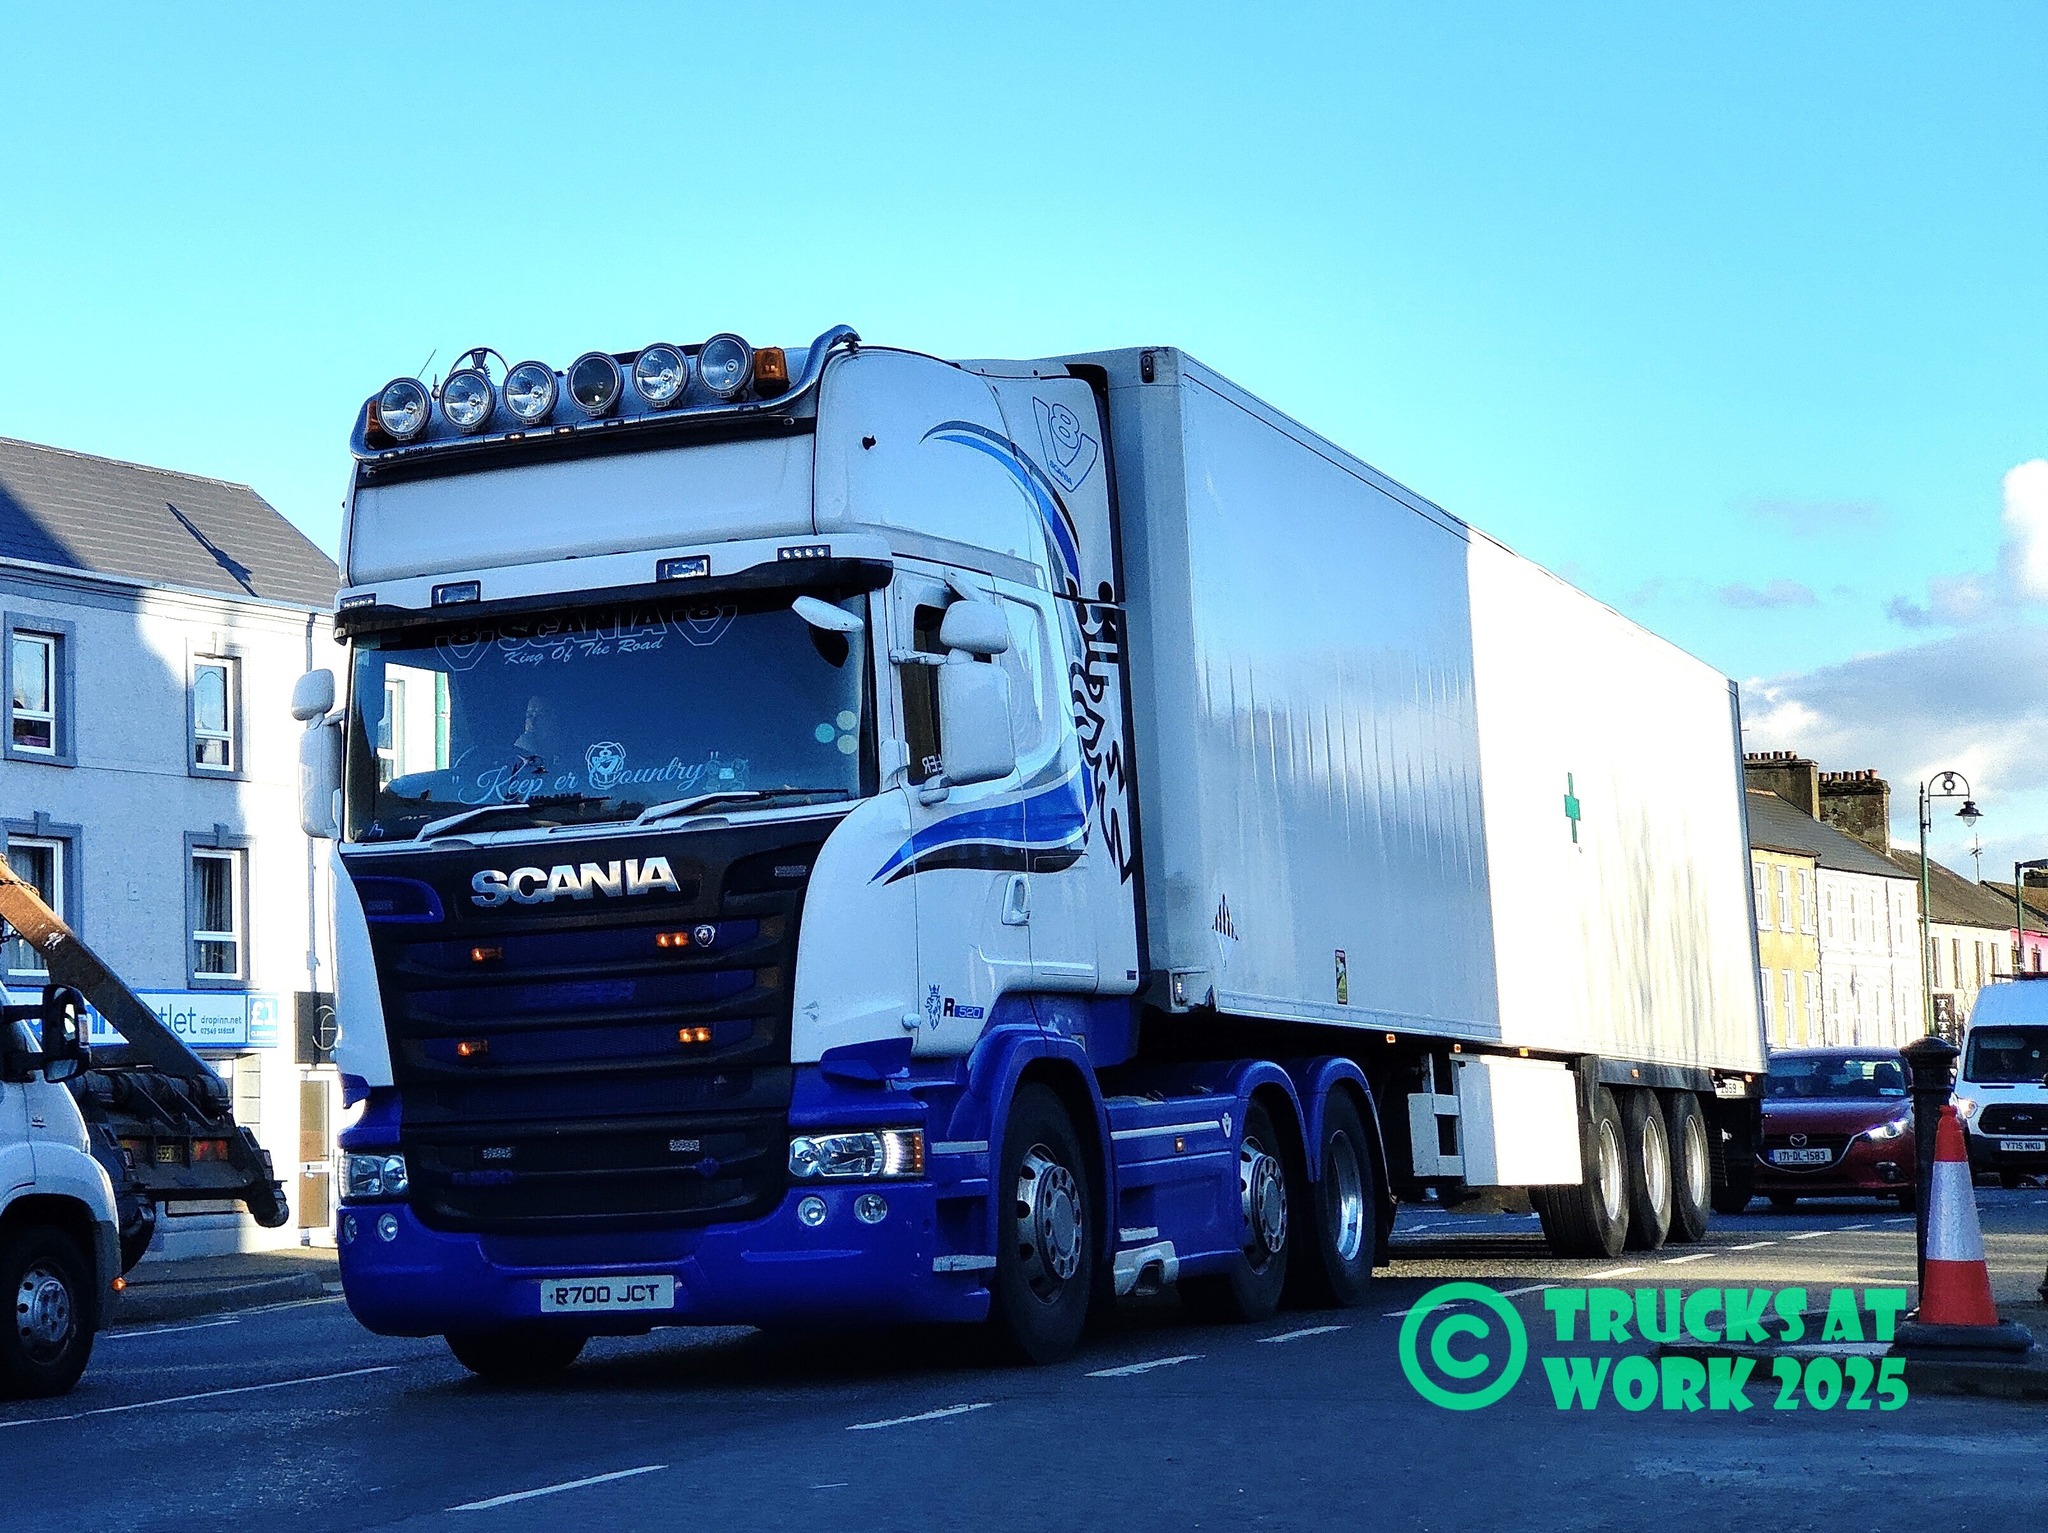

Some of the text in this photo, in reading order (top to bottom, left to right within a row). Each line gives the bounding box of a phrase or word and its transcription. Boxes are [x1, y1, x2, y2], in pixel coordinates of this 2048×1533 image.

[503, 637, 663, 666] King Of The Road
[554, 772, 578, 791] er
[471, 856, 681, 908] SCANIA
[943, 997, 981, 1018] R 520
[201, 1015, 242, 1026] dropinn.net
[1936, 998, 1951, 1040] TATT
[1779, 1151, 1826, 1161] 171-DL-1583
[555, 1284, 659, 1305] R700 JCT
